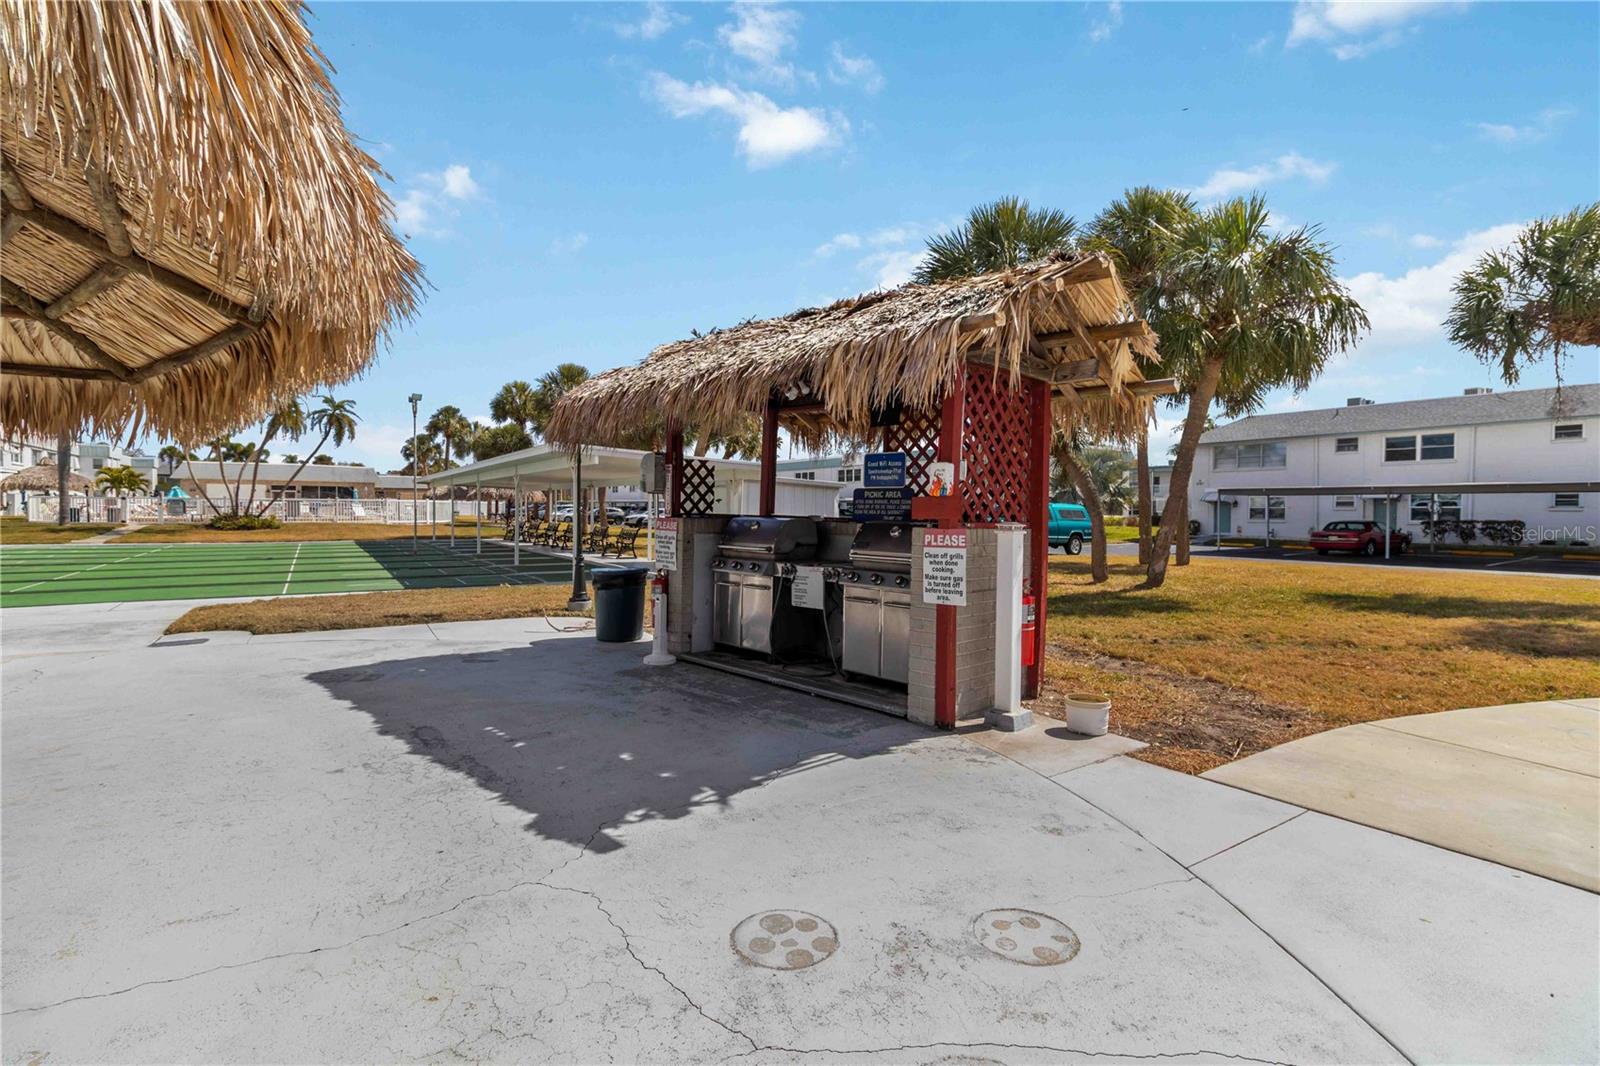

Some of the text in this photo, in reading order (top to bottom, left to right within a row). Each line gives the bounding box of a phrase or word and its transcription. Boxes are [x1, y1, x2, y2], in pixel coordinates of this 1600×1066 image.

[657, 520, 678, 529] PLEASE
[925, 534, 966, 546] PLEASE
[949, 553, 964, 561] grills
[943, 588, 963, 597] leaving
